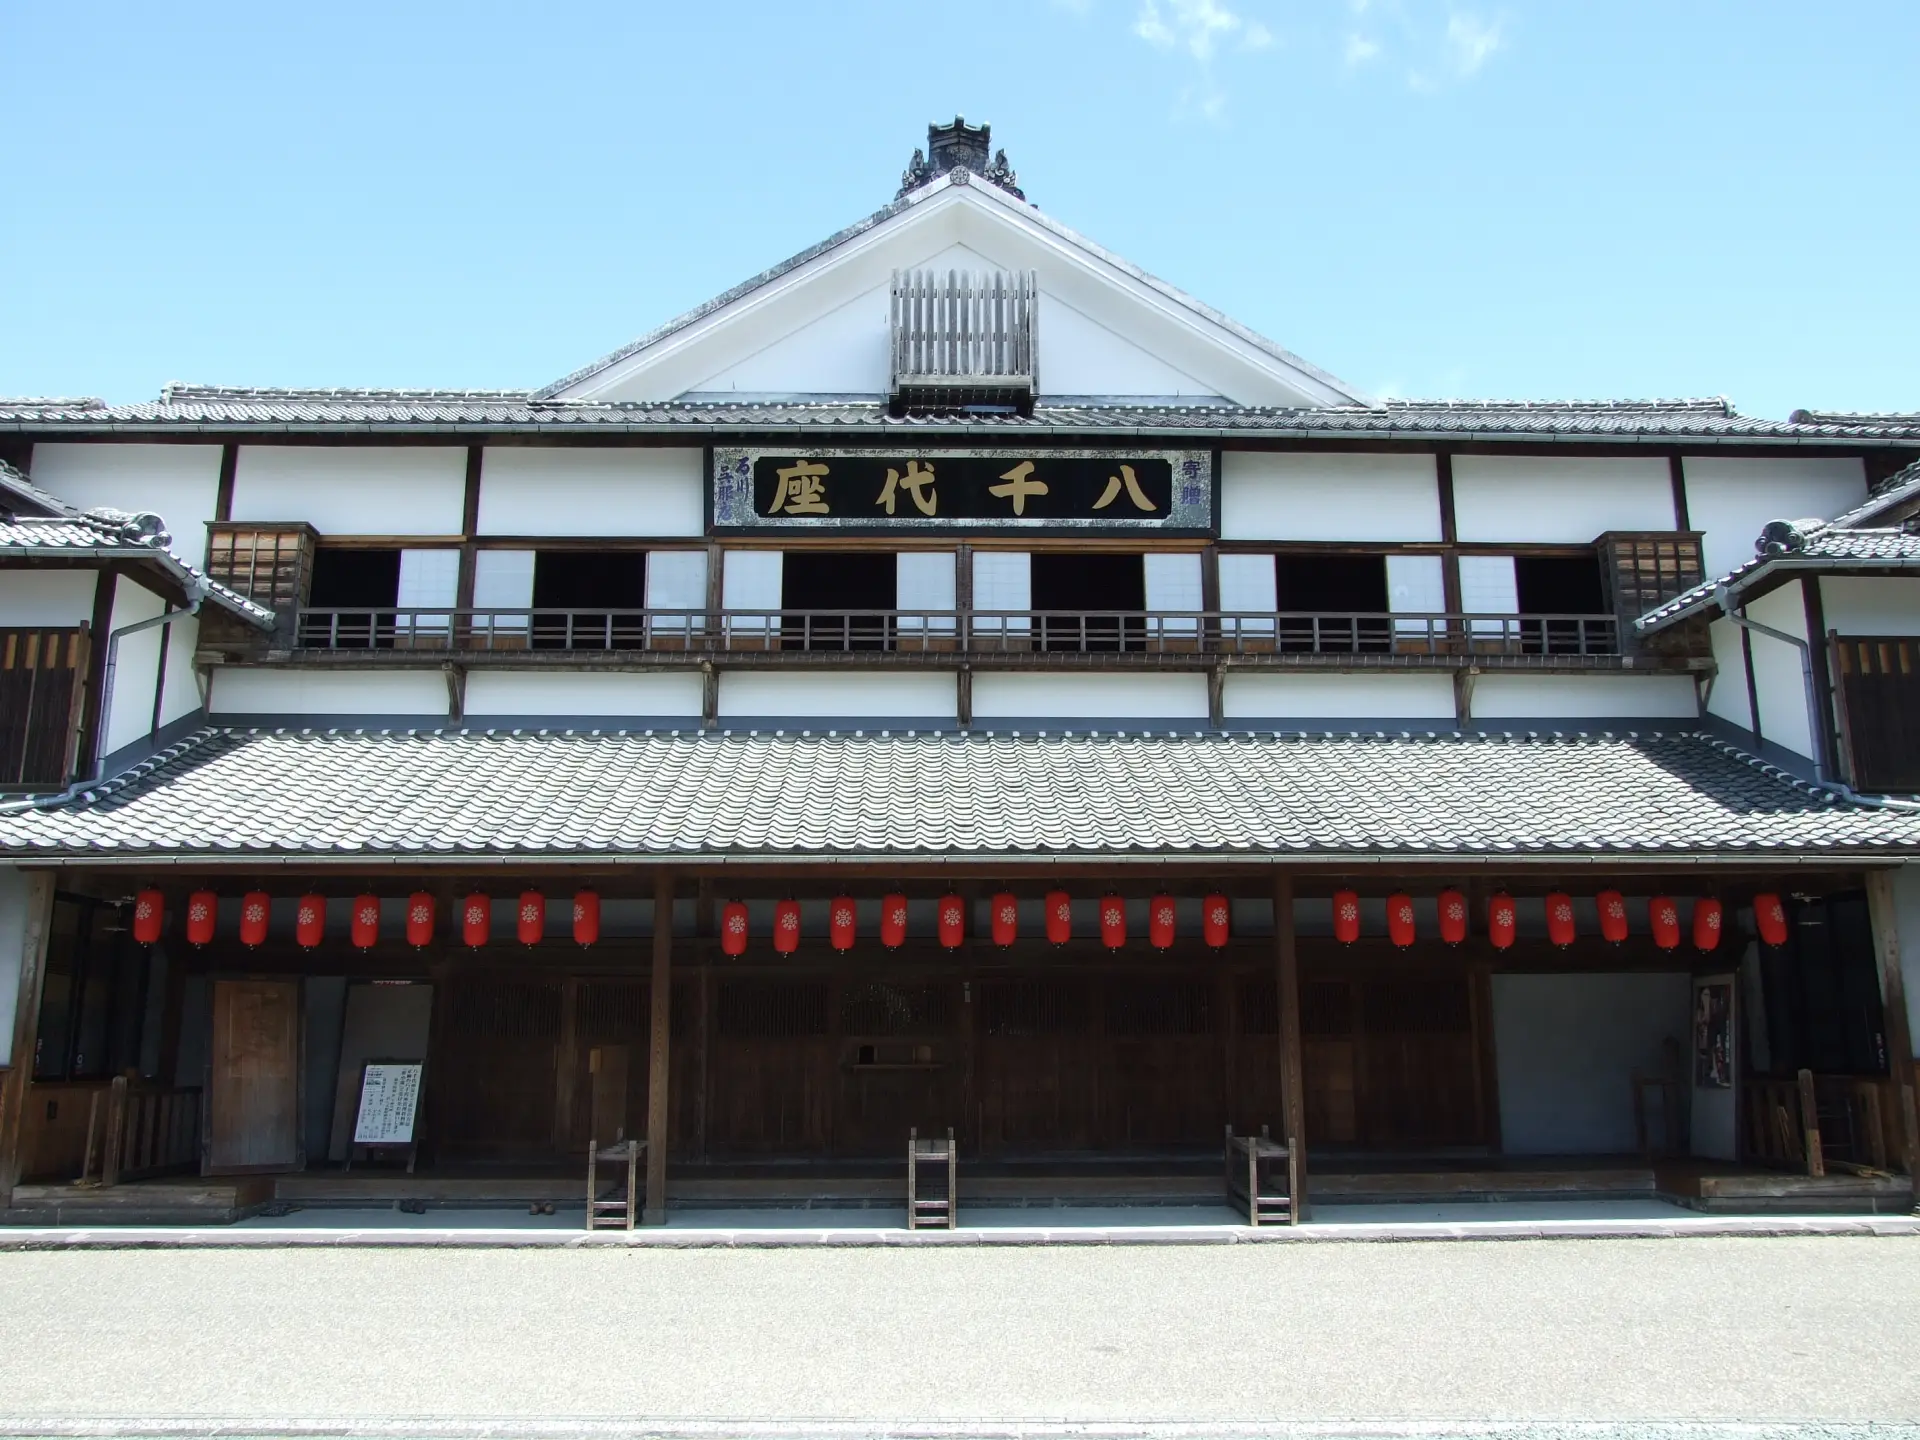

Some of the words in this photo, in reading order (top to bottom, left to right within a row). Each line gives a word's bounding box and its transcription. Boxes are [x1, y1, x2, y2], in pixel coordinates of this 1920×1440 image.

[767, 460, 1157, 516] 八千代座
[1182, 460, 1201, 504] 寄贈
